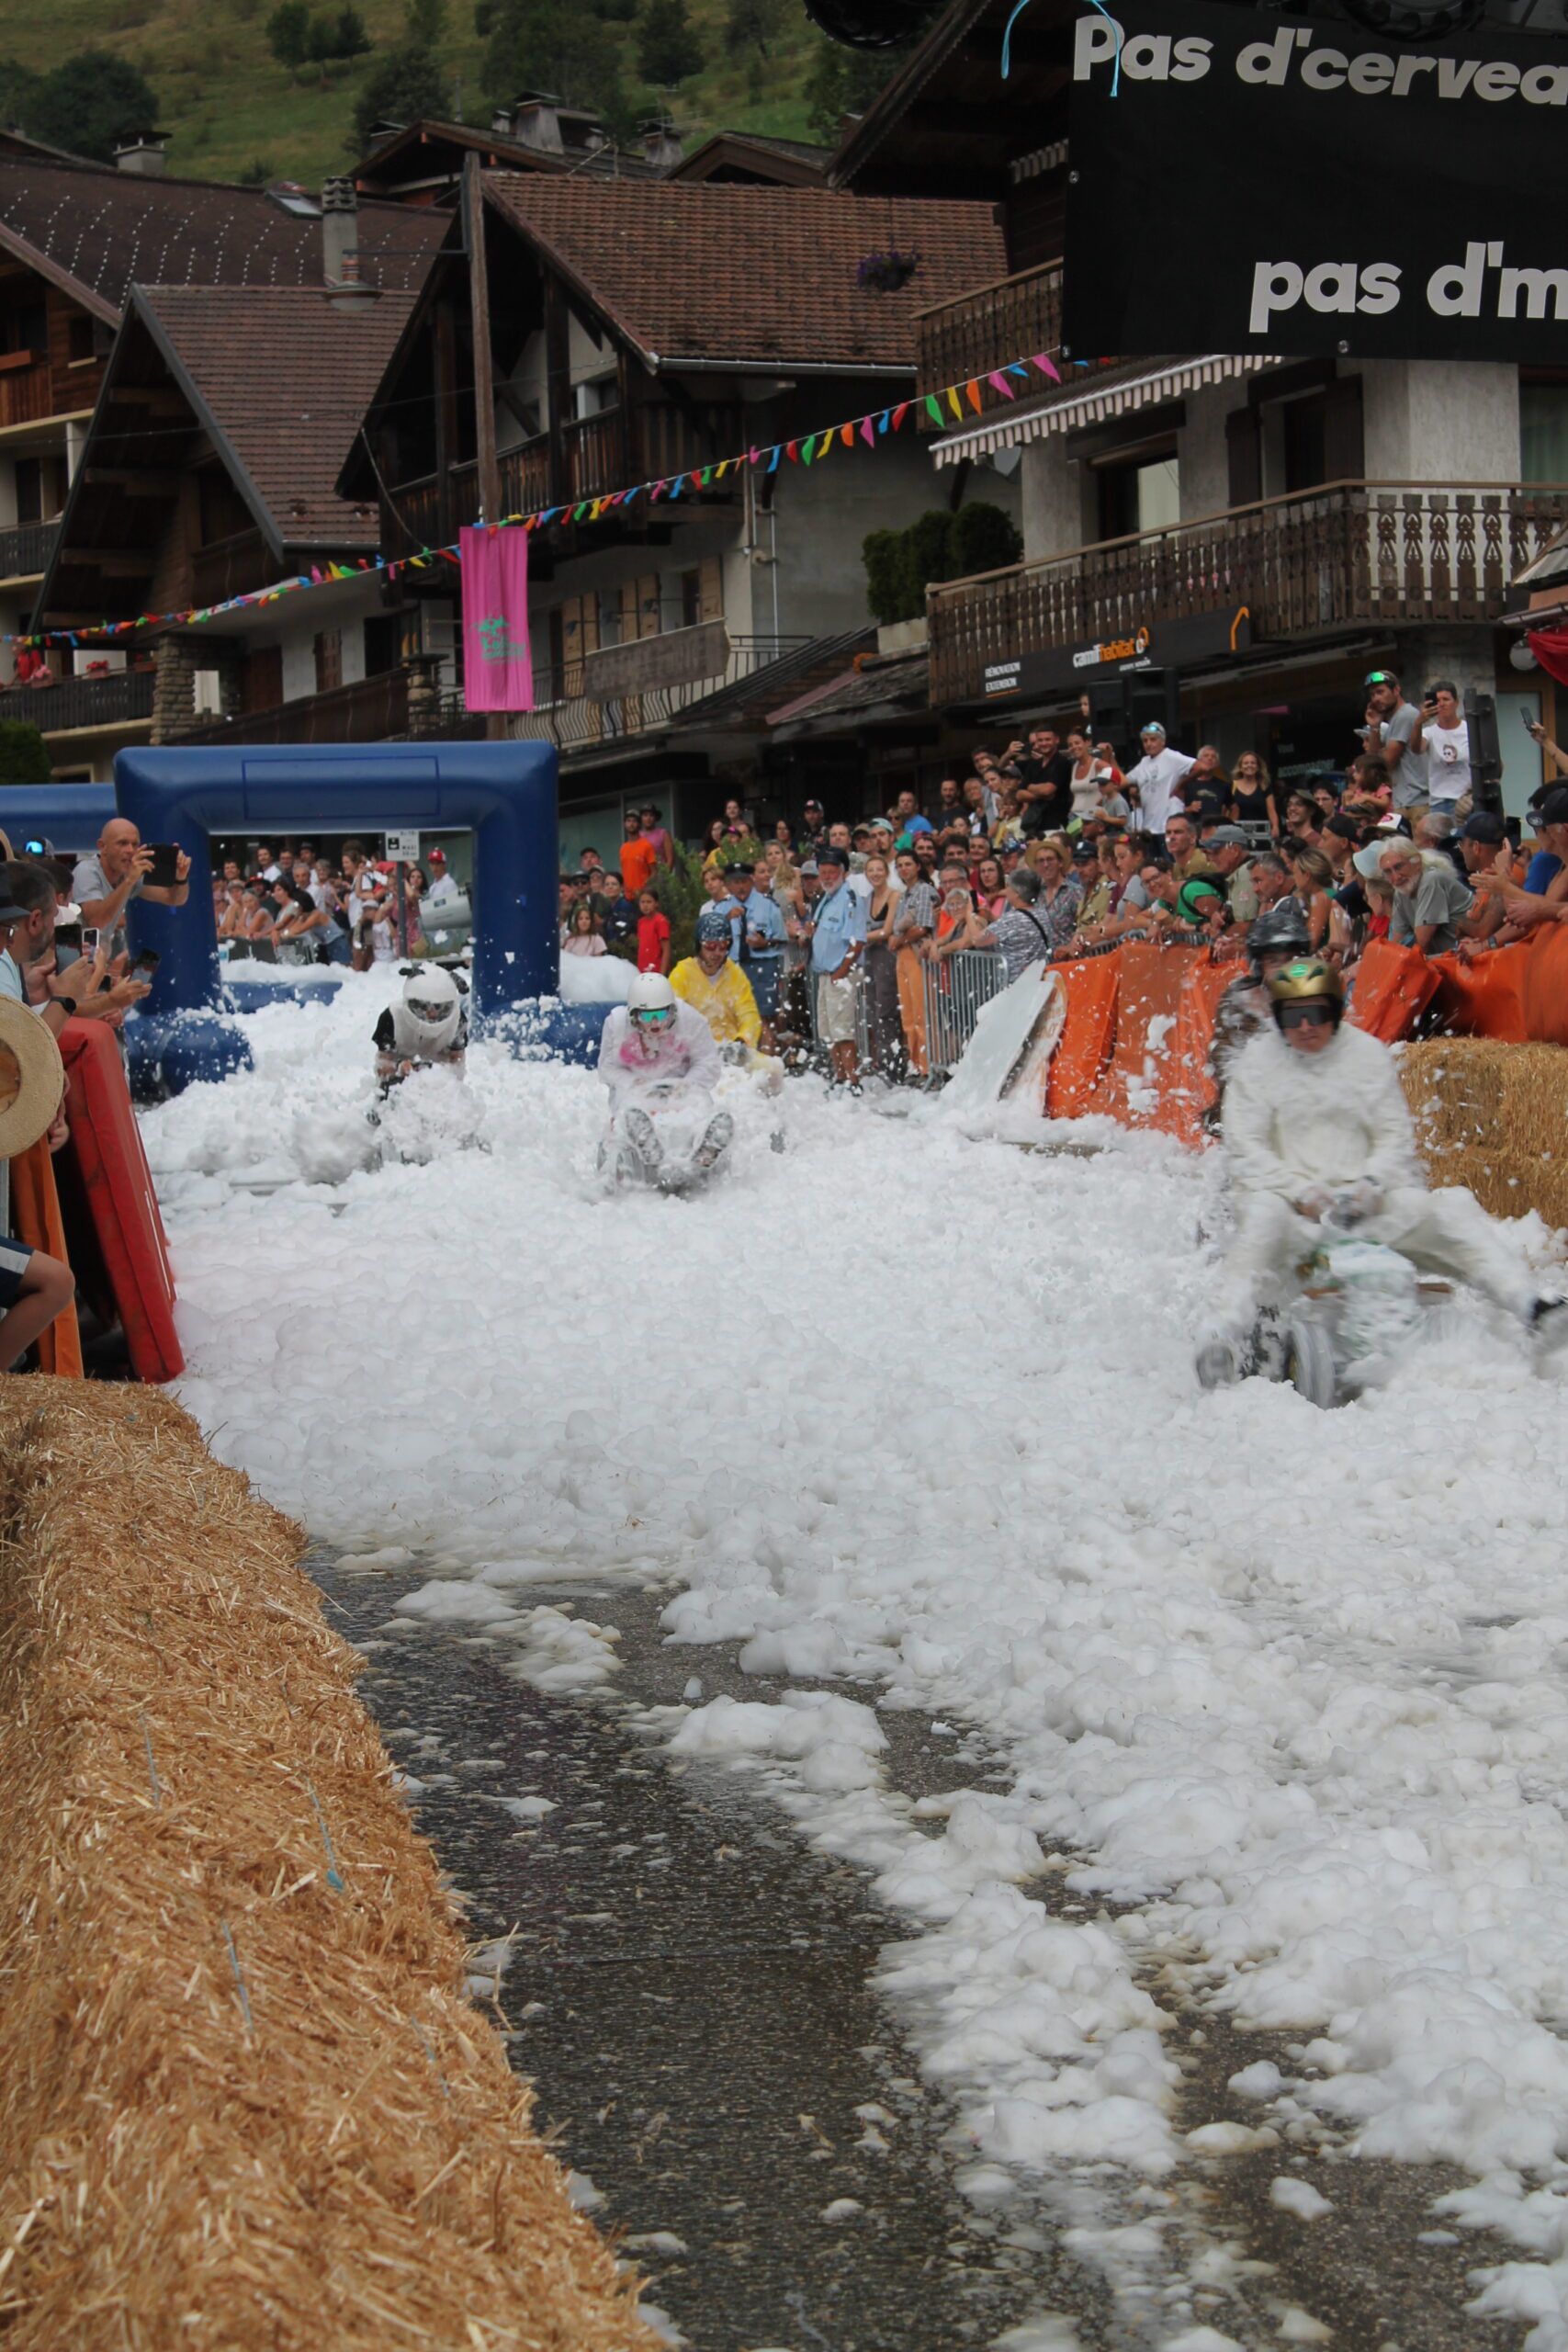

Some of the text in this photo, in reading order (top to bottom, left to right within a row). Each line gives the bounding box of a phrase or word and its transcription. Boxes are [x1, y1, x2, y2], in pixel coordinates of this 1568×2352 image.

[1073, 15, 1568, 106] Pas d'cervea
[1248, 241, 1568, 334] pas d'm
